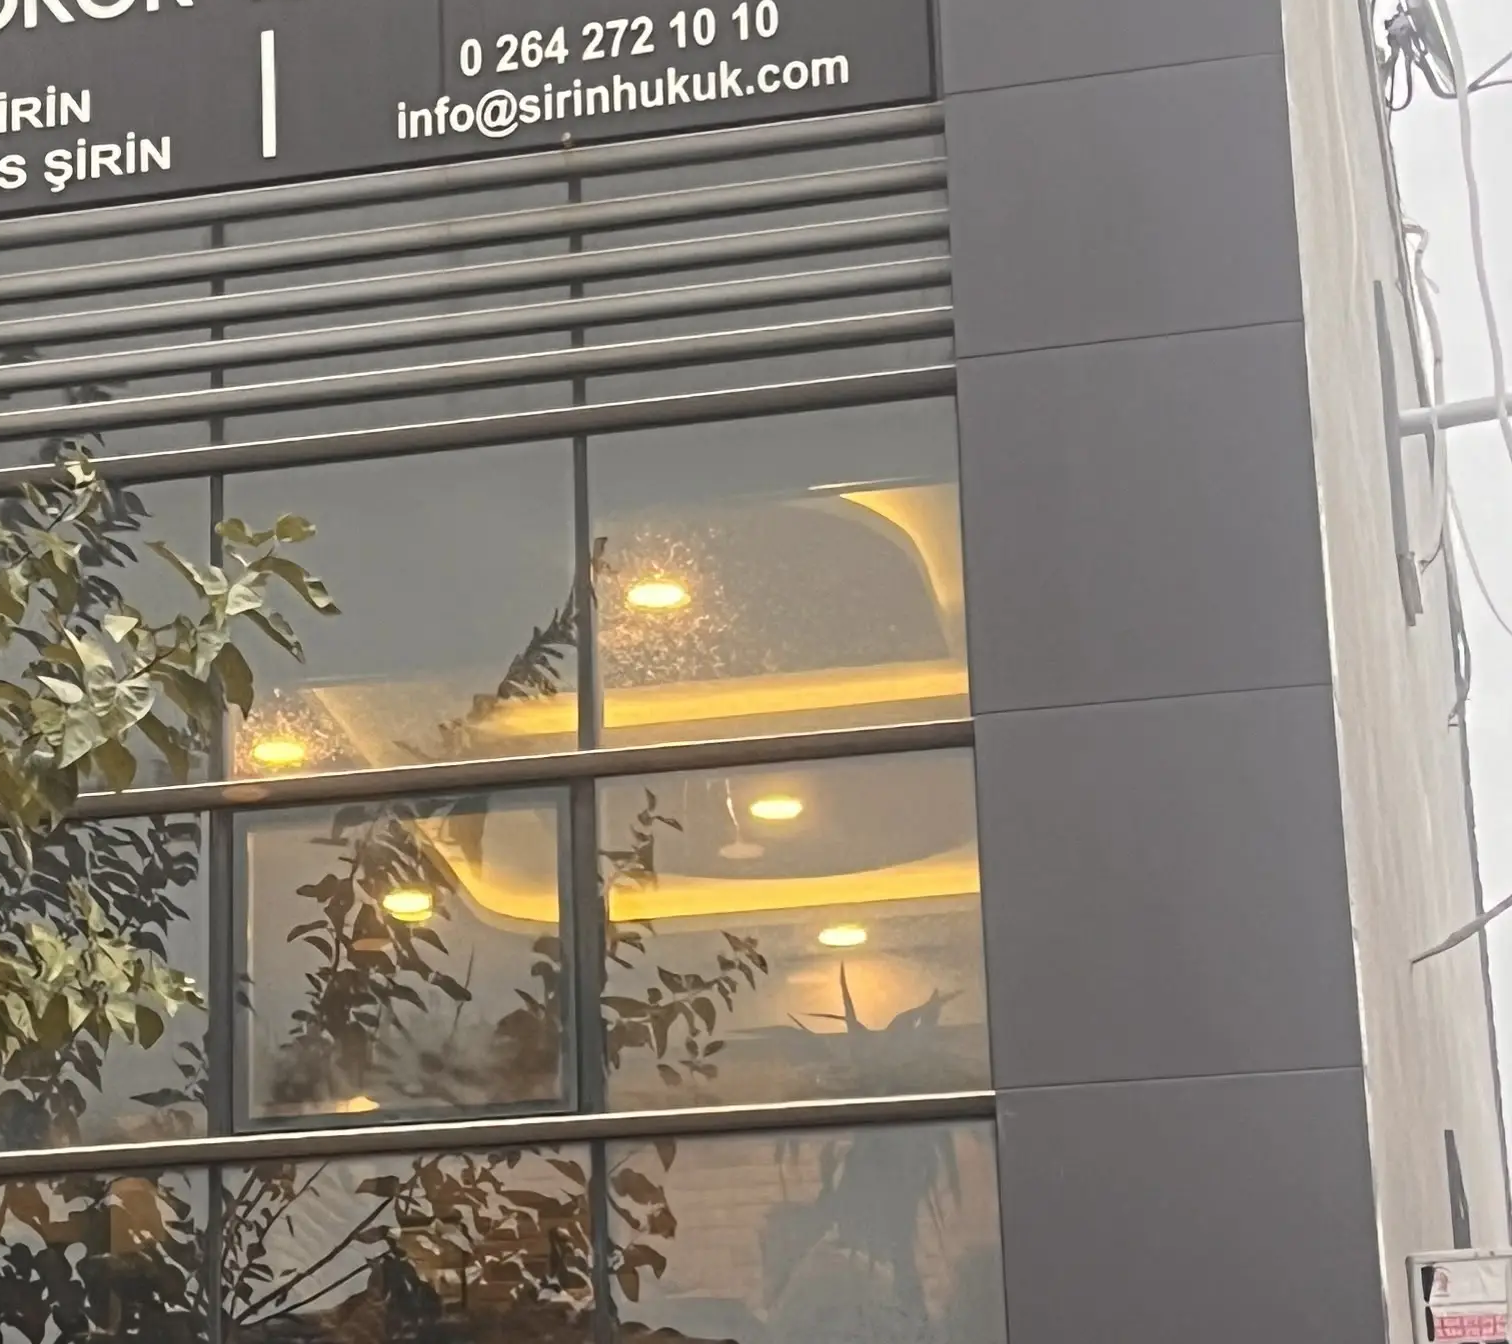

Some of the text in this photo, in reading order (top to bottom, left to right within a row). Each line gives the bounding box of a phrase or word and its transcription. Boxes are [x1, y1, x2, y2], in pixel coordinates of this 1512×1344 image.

[460, 38, 482, 76] 0
[496, 27, 568, 73] 264
[582, 16, 655, 63] 272
[669, 8, 717, 50] 10
[396, 54, 850, 139] info@sirinhukuk.com
[43, 131, 171, 193] ŞİRİN
